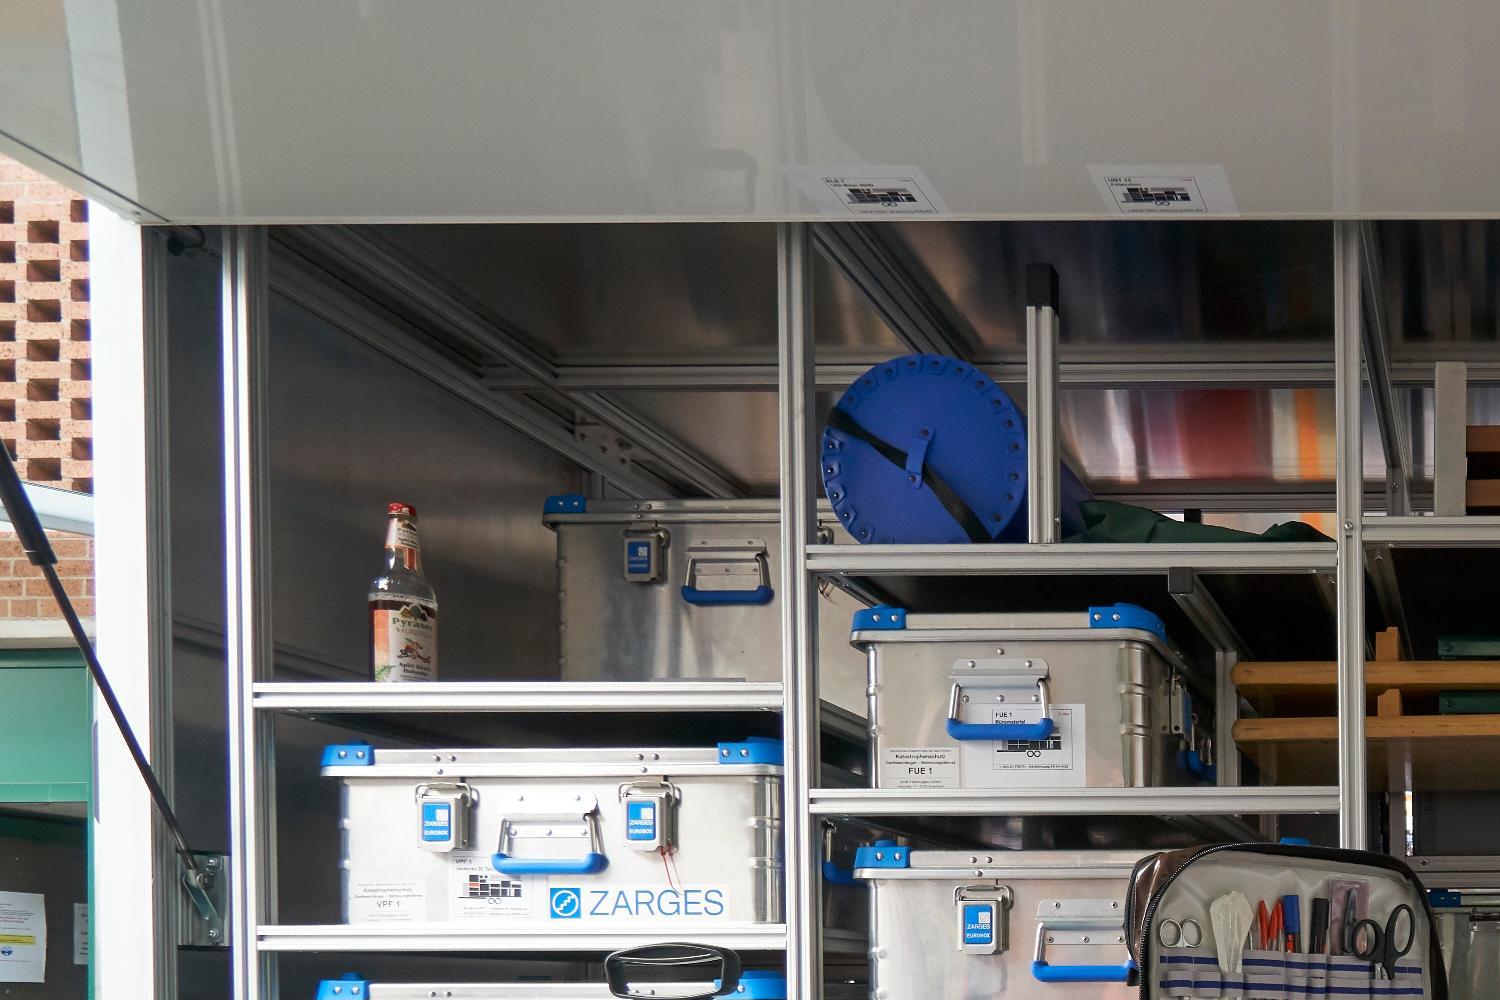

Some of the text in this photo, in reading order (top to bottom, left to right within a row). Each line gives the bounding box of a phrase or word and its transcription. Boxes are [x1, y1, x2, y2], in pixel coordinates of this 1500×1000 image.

[908, 767, 926, 775] FUE
[376, 900, 393, 908] VPF
[589, 889, 725, 917] ZARGES
